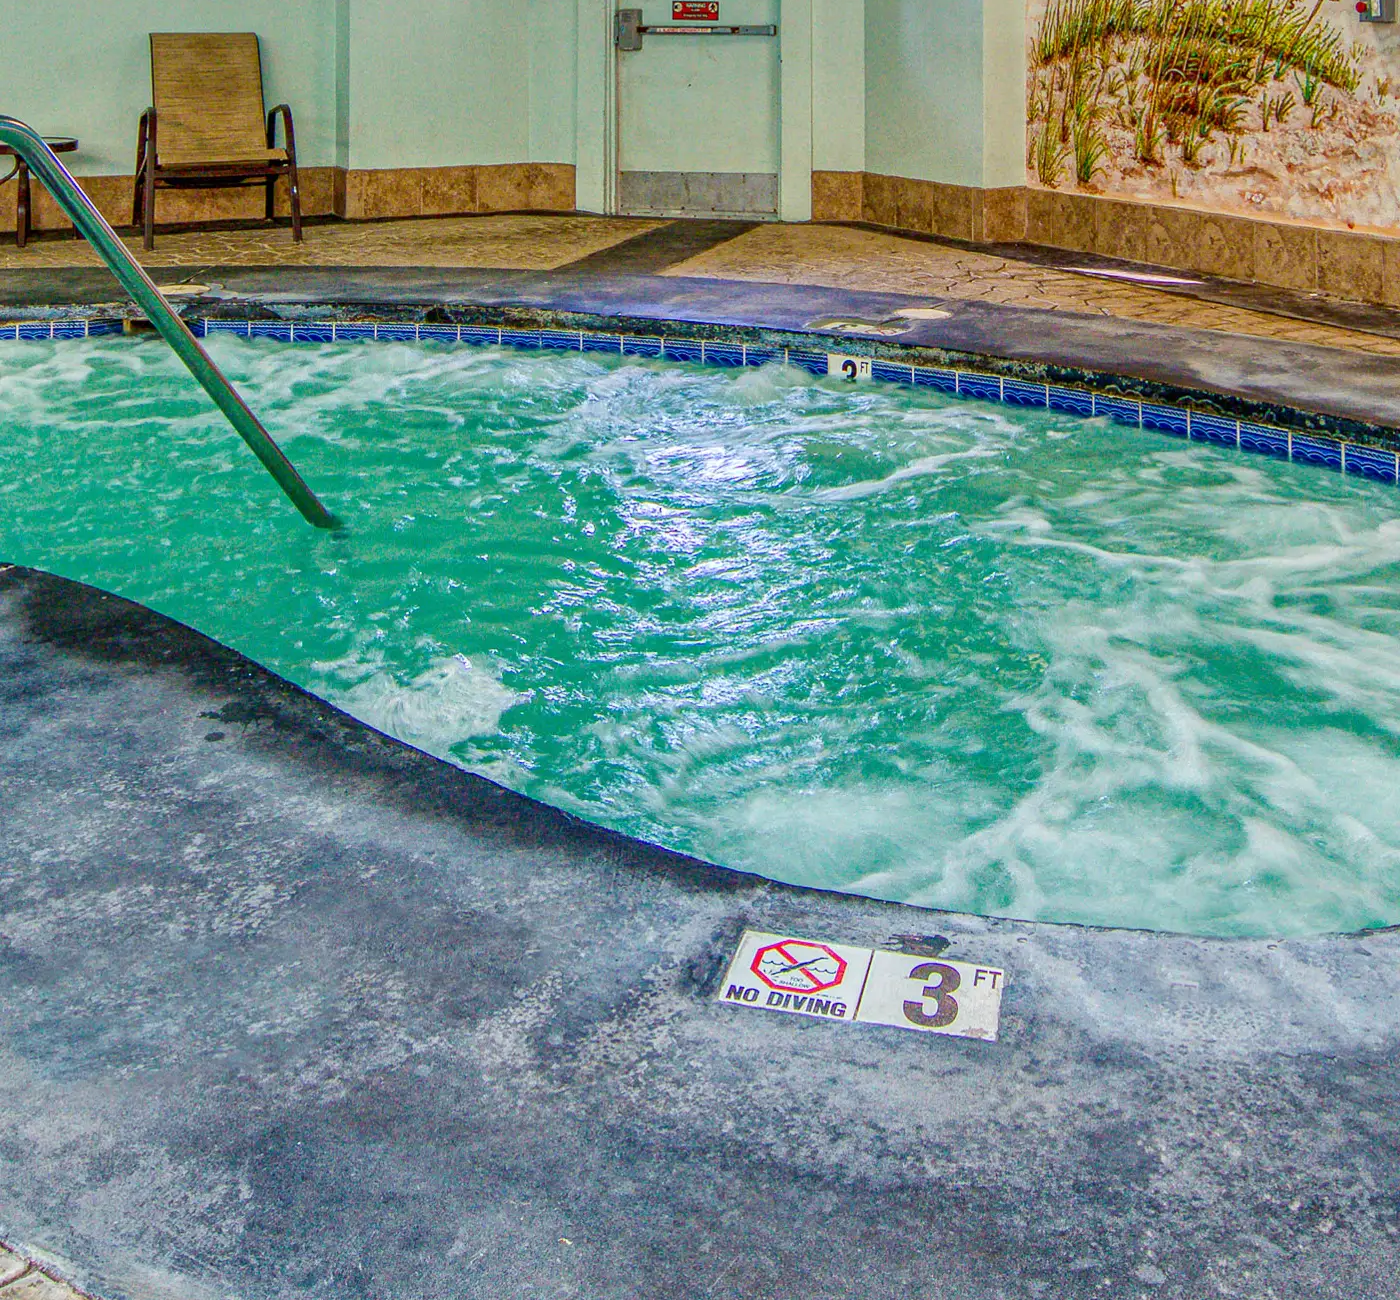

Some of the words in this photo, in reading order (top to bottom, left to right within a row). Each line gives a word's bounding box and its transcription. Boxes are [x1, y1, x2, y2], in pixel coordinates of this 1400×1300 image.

[860, 361, 869, 374] FT
[779, 979, 811, 989] SHALLOW
[902, 962, 962, 1028] 3
[973, 968, 1002, 990] FT
[725, 984, 760, 1002] NO
[766, 991, 847, 1018] DIVING
